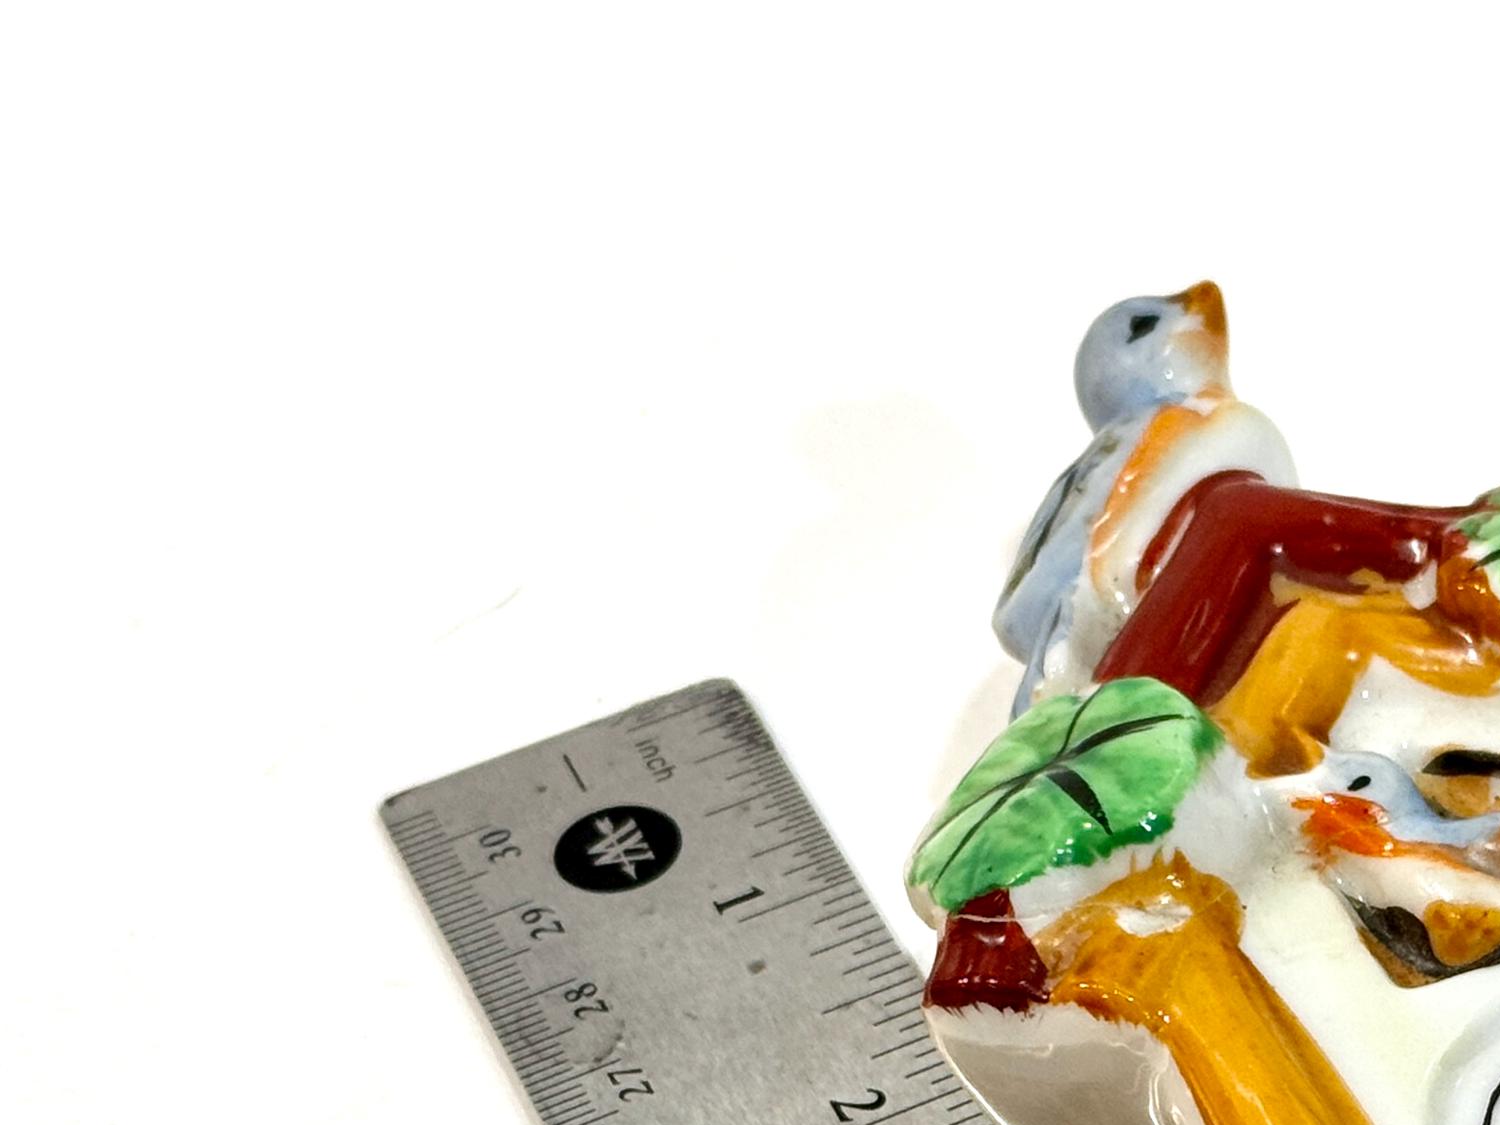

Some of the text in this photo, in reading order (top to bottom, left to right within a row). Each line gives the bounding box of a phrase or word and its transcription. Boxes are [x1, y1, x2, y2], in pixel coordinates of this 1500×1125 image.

[635, 738, 676, 783] inch
[478, 829, 522, 863] 30
[712, 885, 765, 915] 1
[520, 906, 566, 940] 29
[563, 981, 609, 1021] 28
[608, 1066, 654, 1103] 27
[830, 1088, 887, 1122] 2
